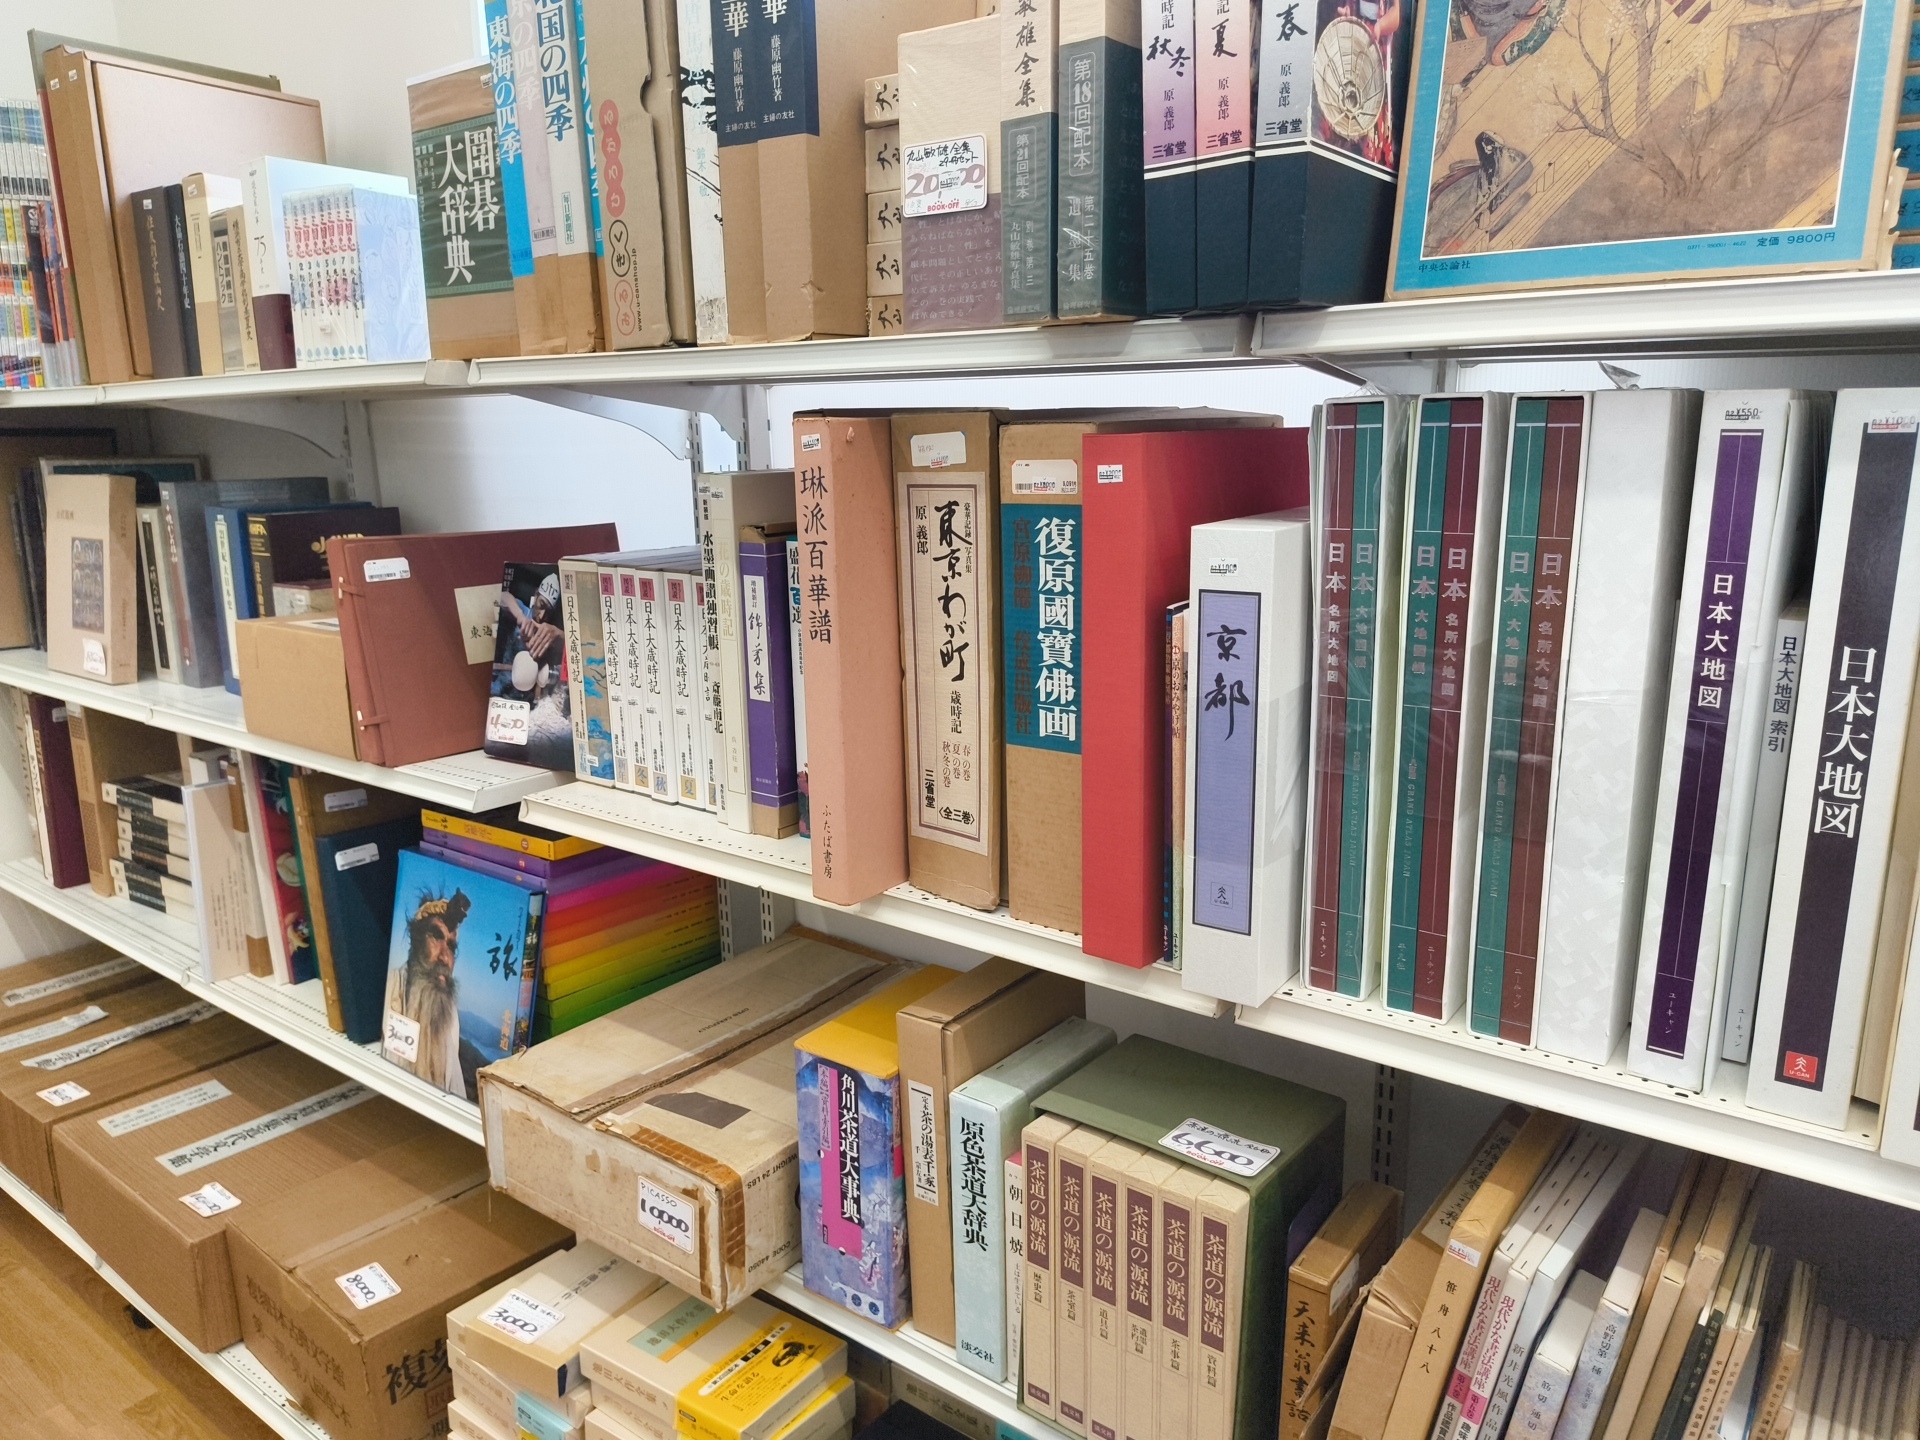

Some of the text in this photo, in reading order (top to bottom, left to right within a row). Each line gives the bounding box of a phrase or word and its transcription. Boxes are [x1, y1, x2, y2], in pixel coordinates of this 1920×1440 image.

[1211, 18, 1238, 57] 夏
[1276, 3, 1308, 42] 春
[488, 15, 522, 165] 東海の四季
[535, 0, 574, 142] 国の四季
[762, 109, 795, 123] 主婦の友社
[1072, 59, 1092, 170] 第18回配本
[1152, 140, 1187, 159] 三省堂
[1206, 129, 1243, 149] 三省堂
[1264, 118, 1303, 137] 三省堂
[603, 108, 621, 208] ひろがる
[1015, 133, 1030, 199] 第21回配本
[436, 135, 476, 286] 大辞典
[561, 192, 574, 244] 毎日新聞社
[1755, 231, 1836, 248] 定価 9800円
[215, 241, 227, 304] ハンドブック
[614, 230, 627, 268] きく
[1418, 260, 1472, 274] 中央公論社
[618, 289, 632, 328] みる
[800, 466, 833, 644] 琳派百華譜
[932, 500, 973, 682] 東京わが町
[566, 596, 582, 684] 日本大歳時記
[604, 596, 621, 686] 日本大歳時記
[625, 597, 641, 689] 日本大歳時記
[643, 601, 660, 695] 日本大歳時記
[673, 603, 690, 698] 日本大歳時記
[1034, 517, 1077, 742] 復原國寶佛画
[1697, 573, 1734, 709] 日本大地図
[950, 690, 963, 734] 歳時記
[1204, 623, 1250, 742] 京都
[1767, 636, 1797, 754] 日本大地図 索引
[636, 766, 648, 787] 冬
[1813, 646, 1878, 839] 日本大地図
[655, 776, 667, 792] 秋
[924, 769, 936, 809] 三省堂
[822, 804, 833, 880] ふたば書房
[486, 932, 519, 982] 旅
[1664, 992, 1676, 1034] ユーキャン
[1735, 1008, 1746, 1048] ユーキャン
[839, 1073, 861, 1224] 角川茶道大事典
[960, 1117, 989, 1252] 原色茶道大辞典
[640, 1182, 678, 1209] PICASSO
[1009, 1185, 1024, 1257] 朝日焼
[1029, 1159, 1047, 1257] 茶道の源流
[1063, 1175, 1081, 1274] 茶道の源流
[1094, 1191, 1114, 1292] 茶道の源流
[1130, 1204, 1150, 1307] 茶道の源流
[1166, 1218, 1187, 1322] 茶道の源流
[1033, 1271, 1042, 1304] 歴史篇
[1203, 1233, 1226, 1339] 茶道の源流
[961, 1339, 995, 1364] 淡交社
[1206, 1353, 1217, 1388] 資料篇
